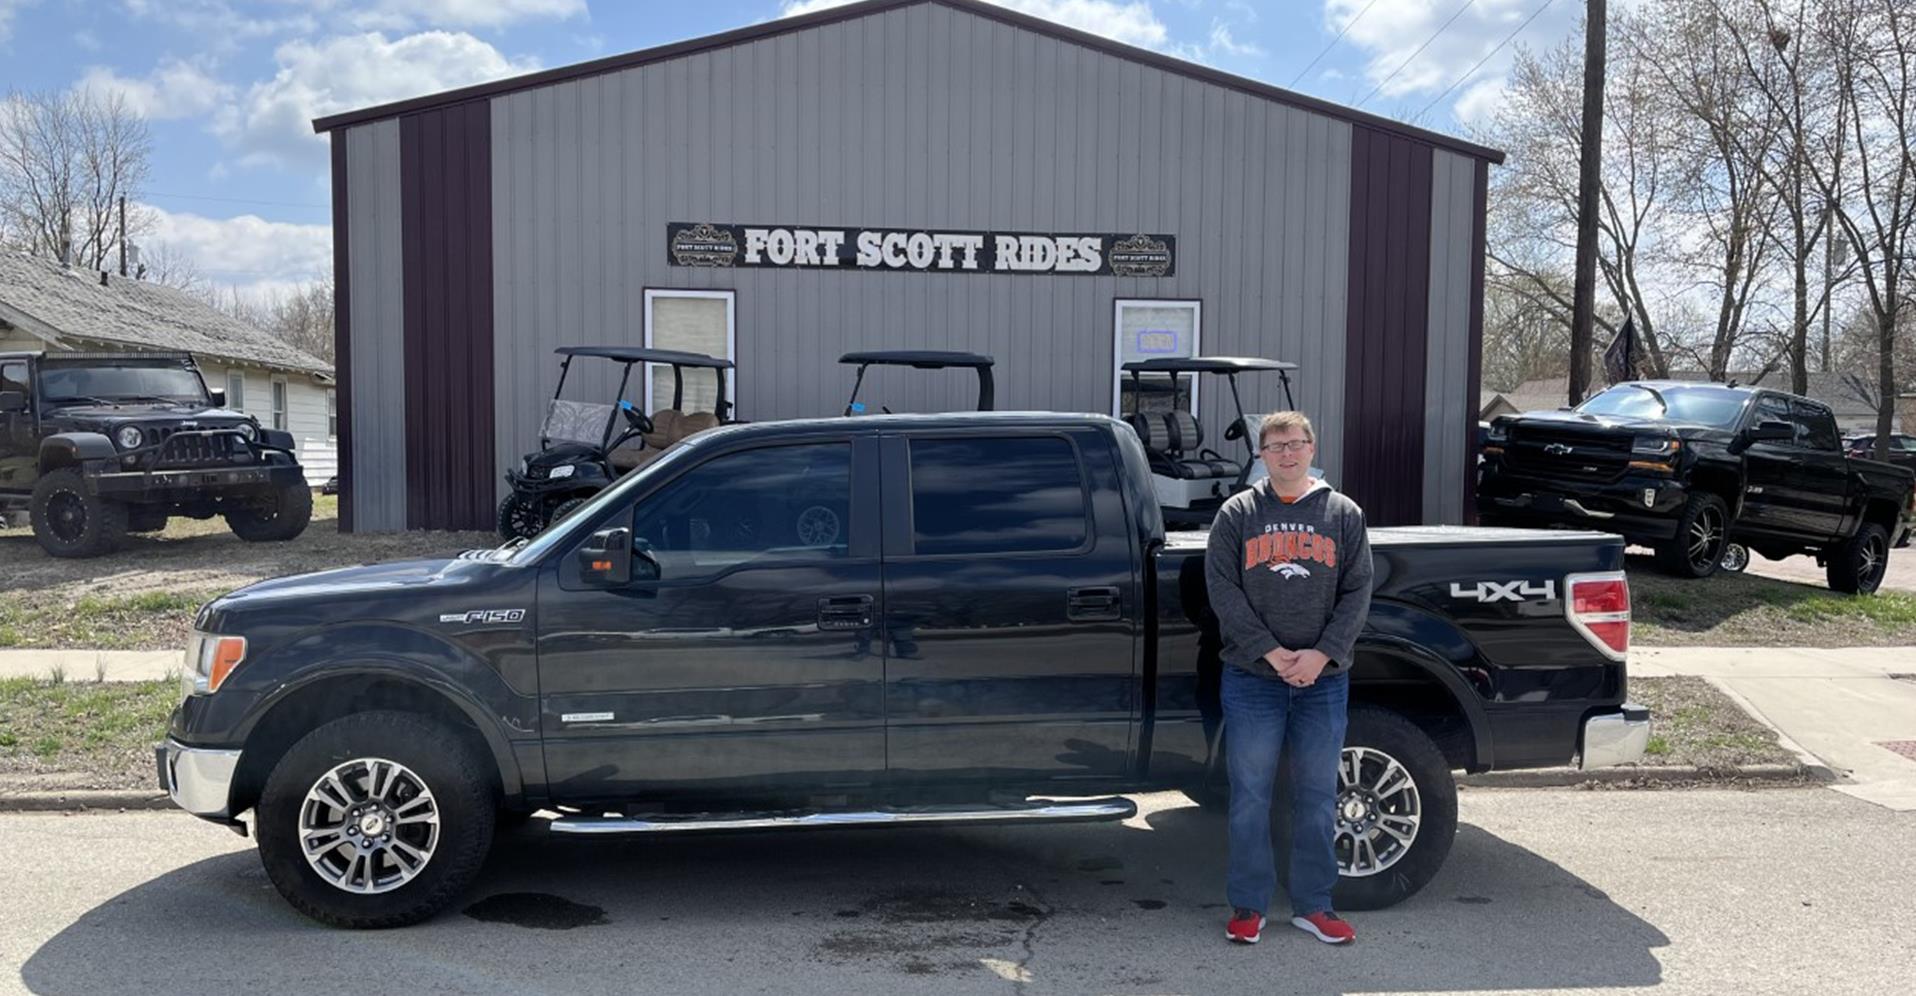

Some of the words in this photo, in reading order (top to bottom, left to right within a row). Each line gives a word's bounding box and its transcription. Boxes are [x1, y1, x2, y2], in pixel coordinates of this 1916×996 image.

[744, 228, 844, 265] FORT
[856, 231, 983, 268] SCOTT
[994, 235, 1102, 272] RIDES
[1264, 523, 1315, 533] DENVER
[1245, 532, 1336, 570] BRONCOS
